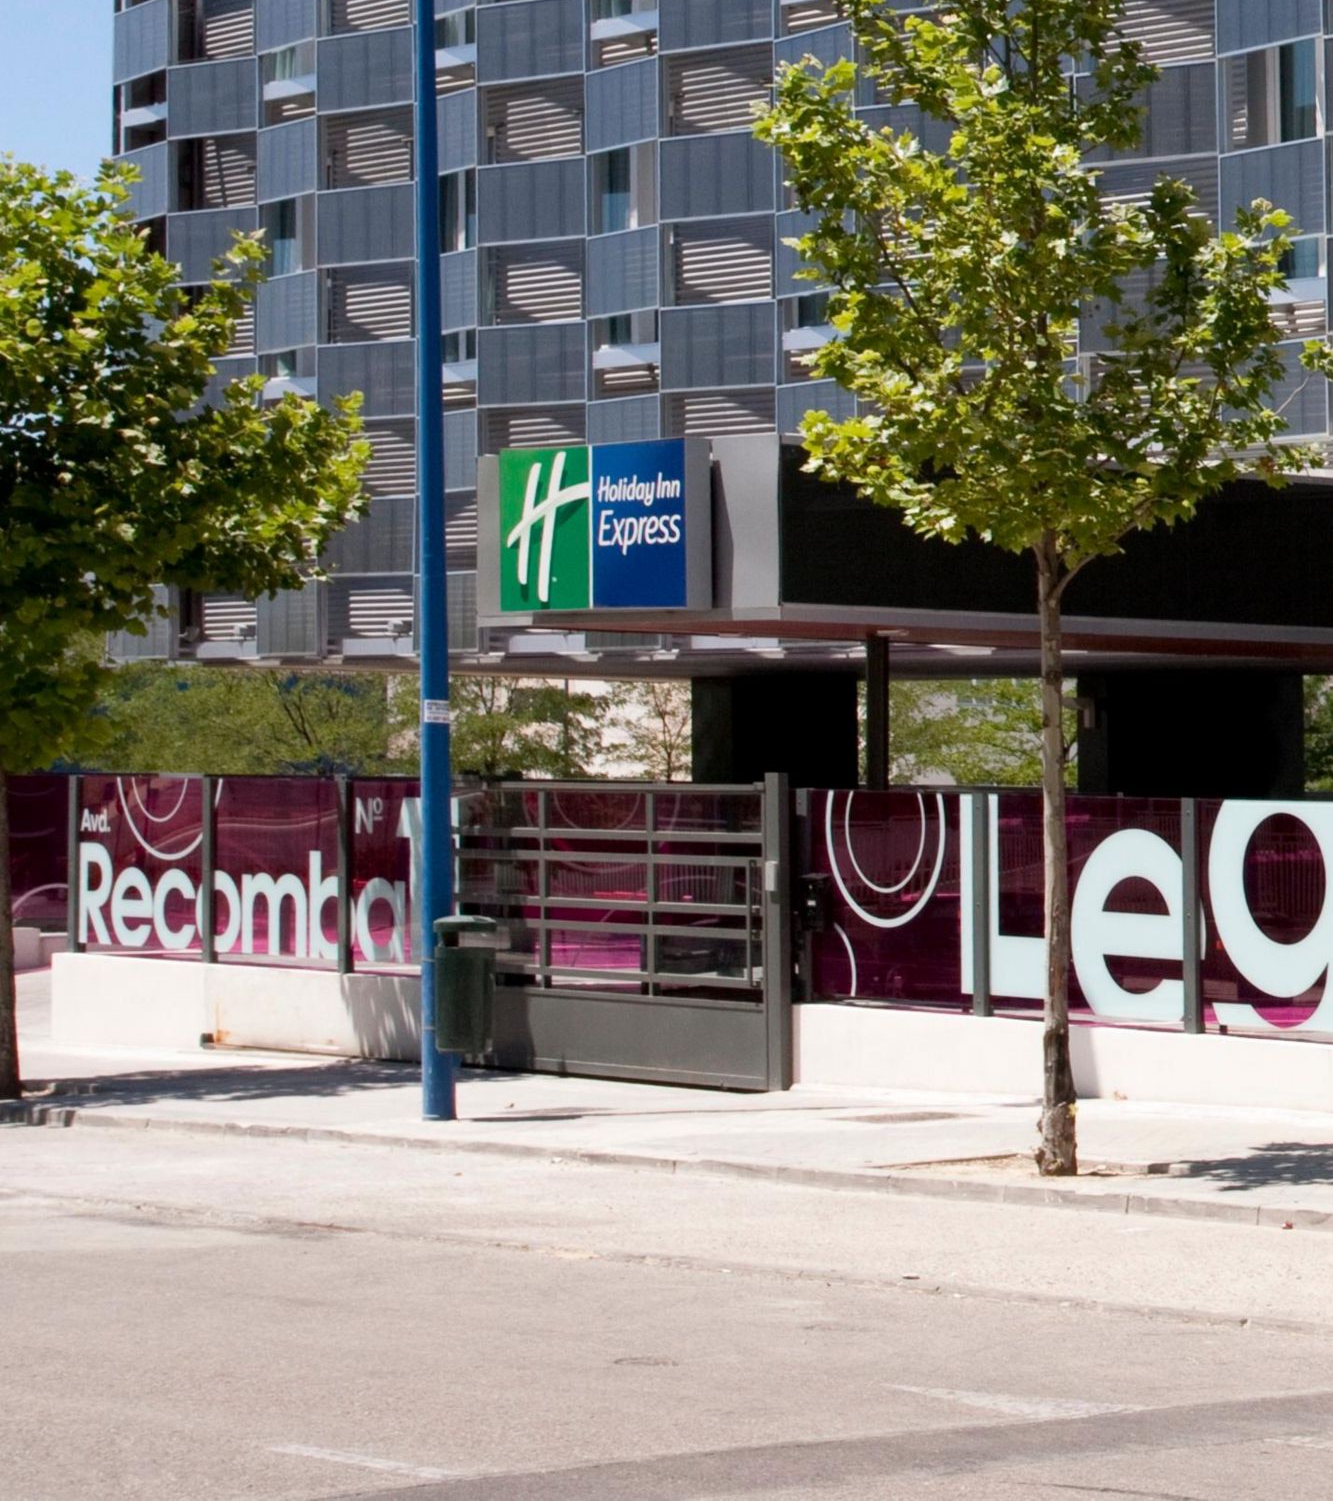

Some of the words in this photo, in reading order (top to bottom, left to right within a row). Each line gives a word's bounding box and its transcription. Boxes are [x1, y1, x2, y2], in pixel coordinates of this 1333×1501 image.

[598, 474, 654, 506] Holiday
[656, 472, 681, 499] Inn
[598, 510, 682, 556] Express
[80, 808, 111, 832] Avd.
[355, 797, 383, 834] Nº
[79, 842, 406, 963] Recomba
